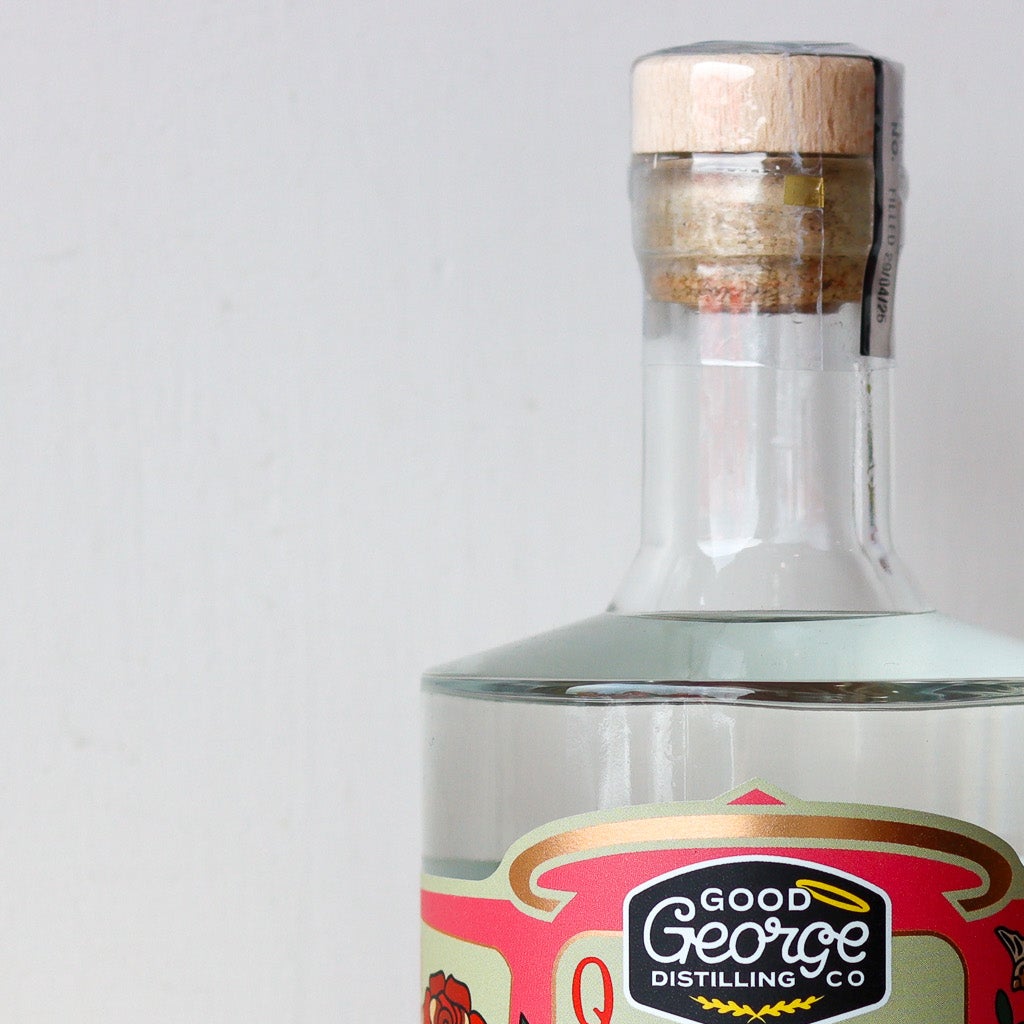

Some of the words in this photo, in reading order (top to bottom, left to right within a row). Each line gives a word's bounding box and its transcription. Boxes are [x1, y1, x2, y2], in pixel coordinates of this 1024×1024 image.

[700, 887, 811, 912] GOOD
[643, 896, 871, 979] George
[651, 970, 796, 989] DISTILLING
[826, 970, 865, 988] CO
